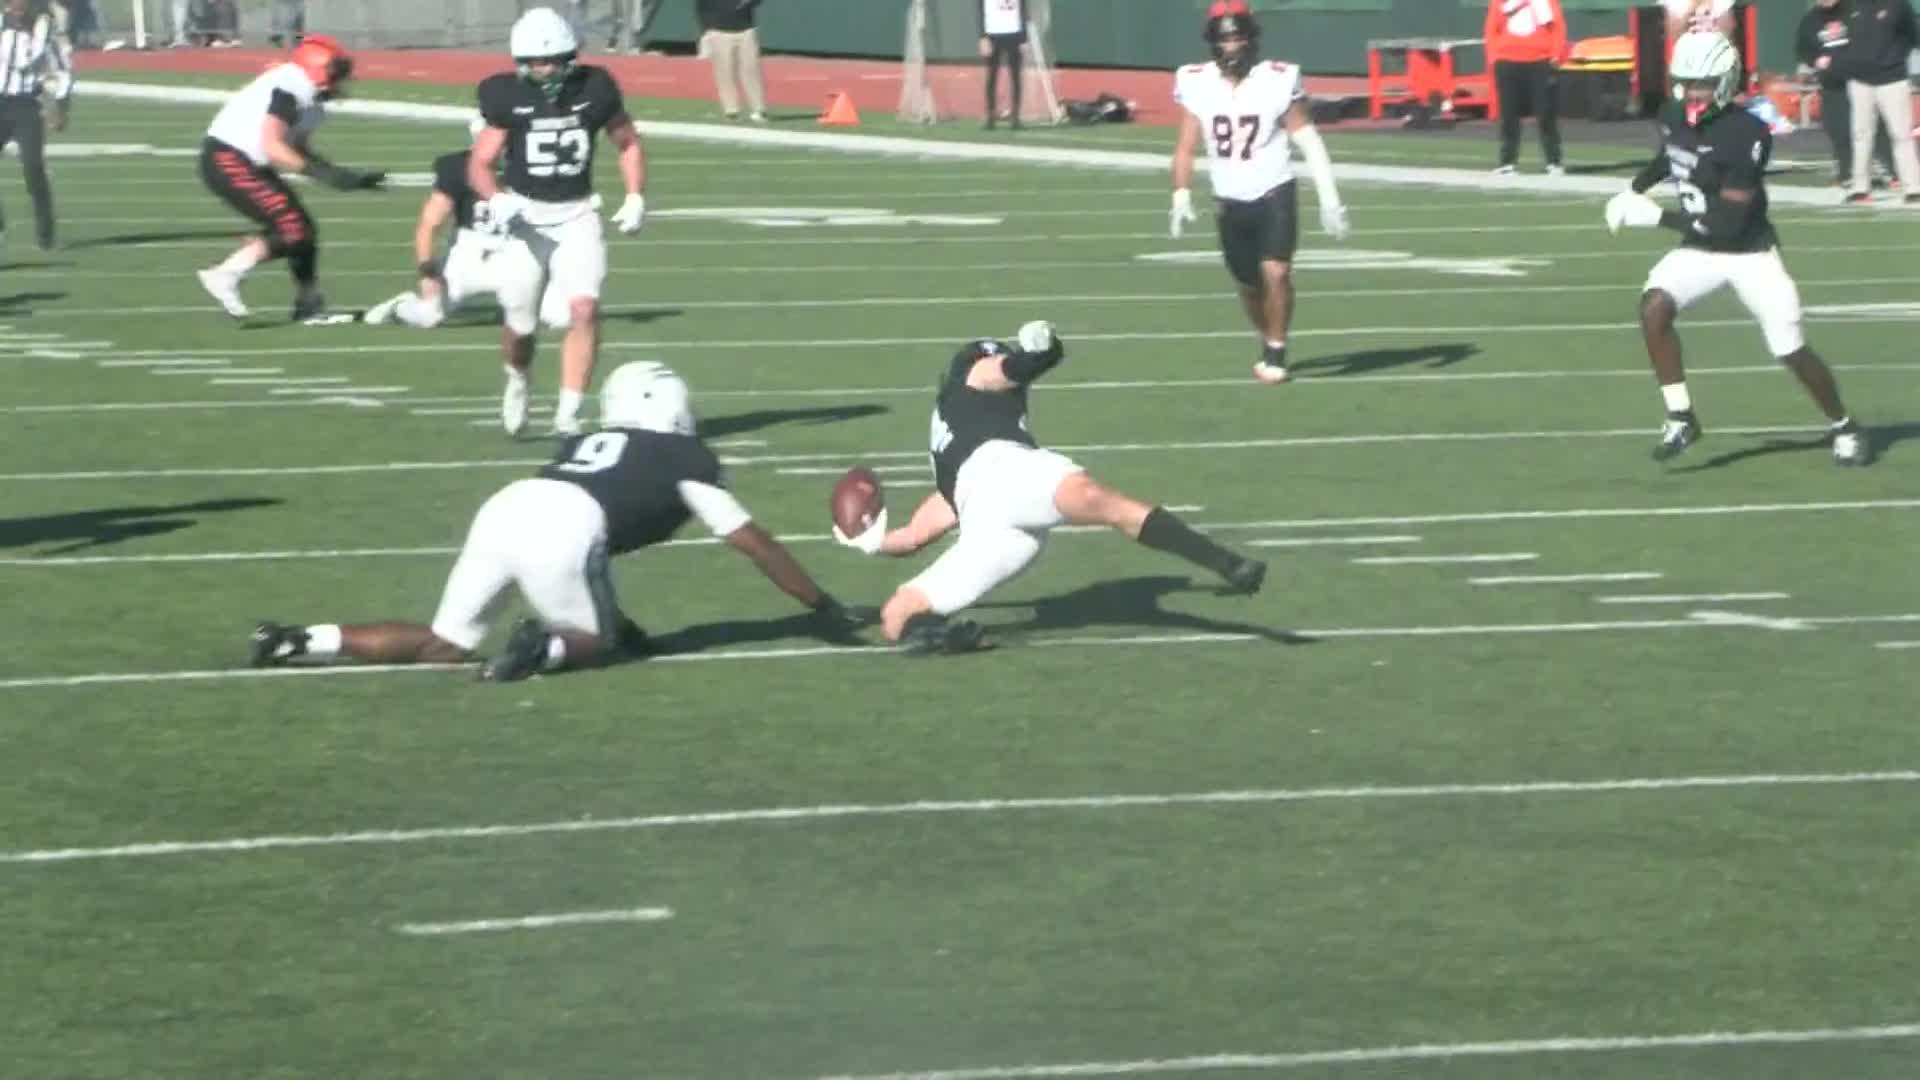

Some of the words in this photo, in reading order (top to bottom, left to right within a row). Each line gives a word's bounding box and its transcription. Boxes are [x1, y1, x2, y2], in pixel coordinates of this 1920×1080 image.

[526, 127, 590, 176] 53
[1212, 113, 1260, 160] 87
[558, 431, 629, 474] 9
